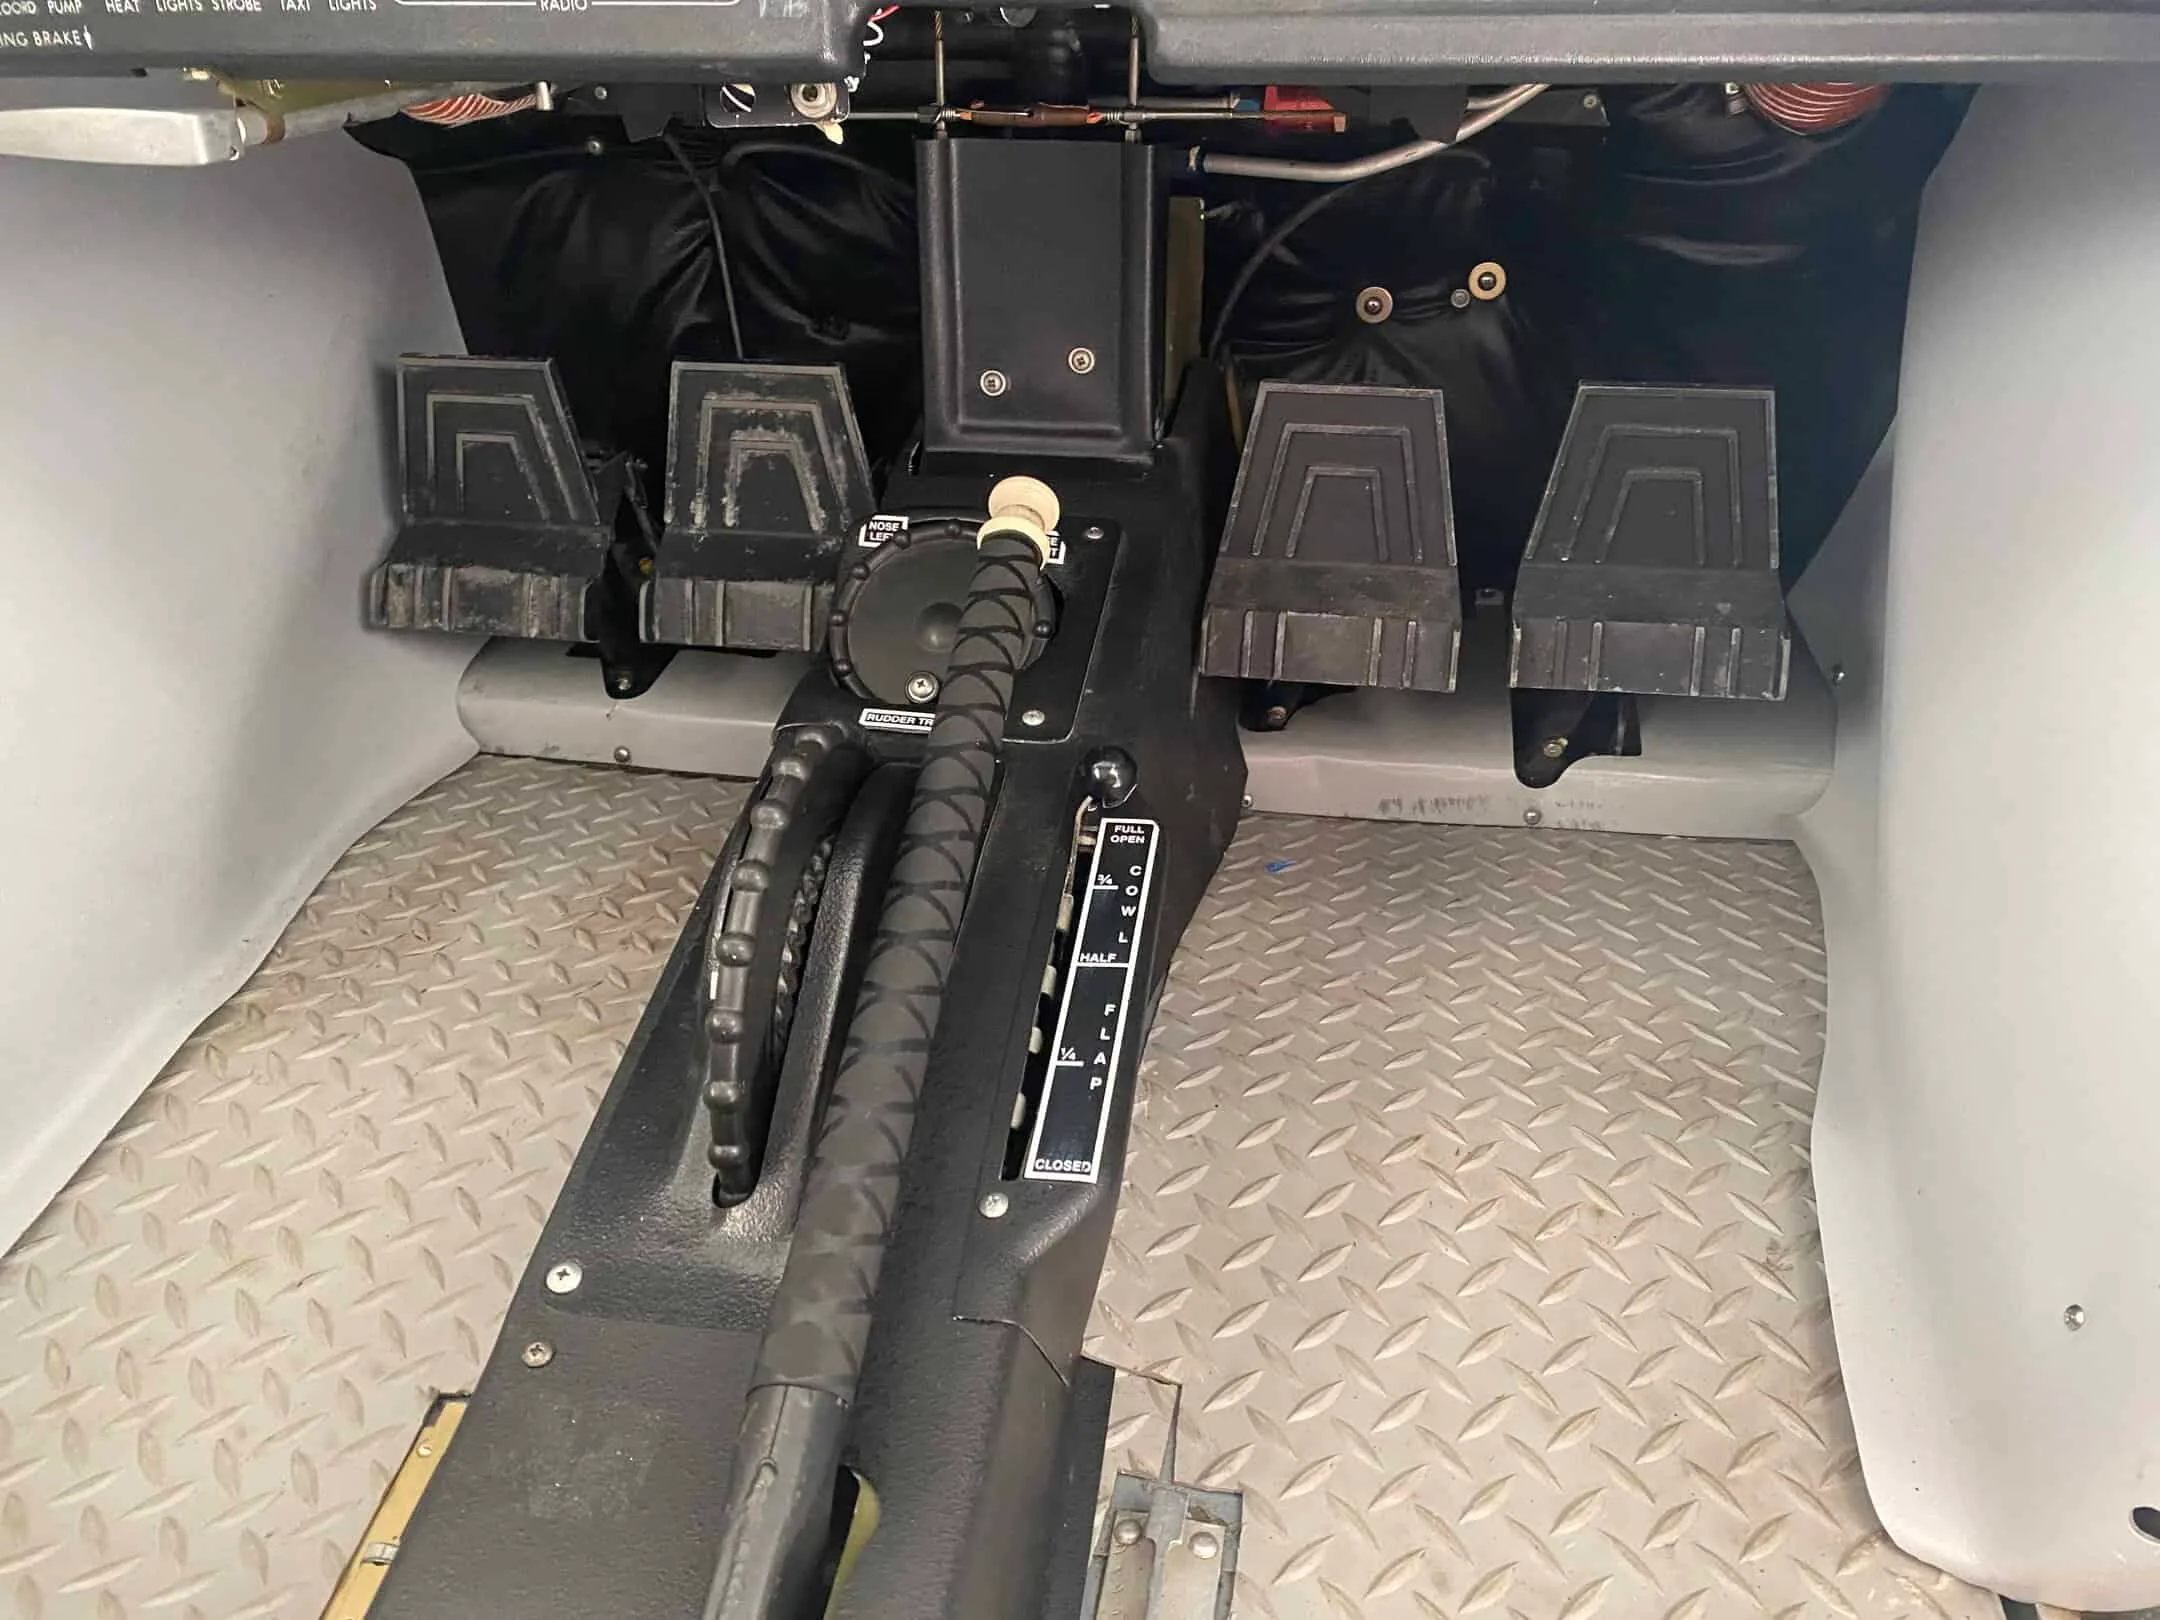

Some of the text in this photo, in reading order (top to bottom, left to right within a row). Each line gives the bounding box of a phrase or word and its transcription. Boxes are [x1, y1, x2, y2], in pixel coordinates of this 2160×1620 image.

[47, 0, 82, 14] PUMP
[104, 0, 140, 13] HEAT
[155, 0, 203, 11] LIGHTS
[212, 0, 262, 11] STROBE
[280, 0, 311, 11] TAXI
[328, 0, 377, 11] LIGHTS
[540, 0, 588, 11] RADIO
[0, 30, 82, 48] ING BRAKE
[869, 521, 900, 532] NOSE
[866, 713, 934, 726] RUDDER TR
[1114, 825, 1145, 833] FULL
[1111, 835, 1145, 844] OPEN
[1080, 953, 1117, 962] HALF
[1035, 1158, 1092, 1172] CLOSED
